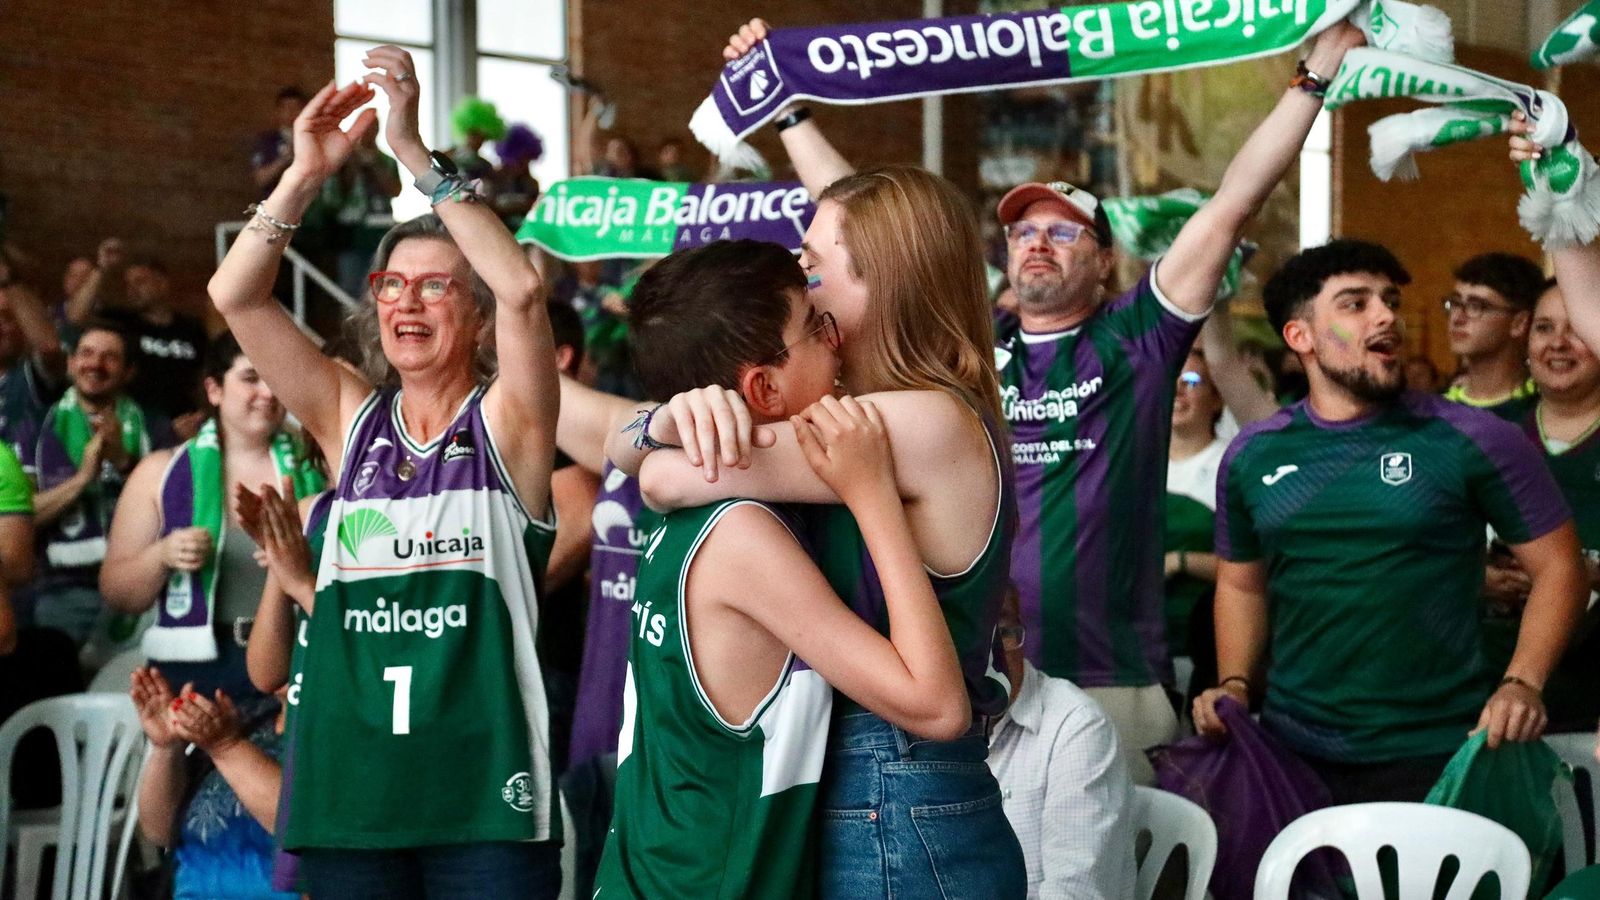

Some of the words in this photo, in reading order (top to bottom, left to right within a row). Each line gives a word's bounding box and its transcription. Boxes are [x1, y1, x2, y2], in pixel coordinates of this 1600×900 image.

[807, 8, 1115, 80] Baloncesto
[526, 184, 638, 238] nicaja
[643, 184, 810, 227] Balonce
[1011, 442, 1049, 453] COSTA
[1050, 440, 1073, 452] DEL
[1074, 438, 1096, 450] SOL
[393, 527, 485, 559] Unicaja
[383, 666, 413, 734] 1
